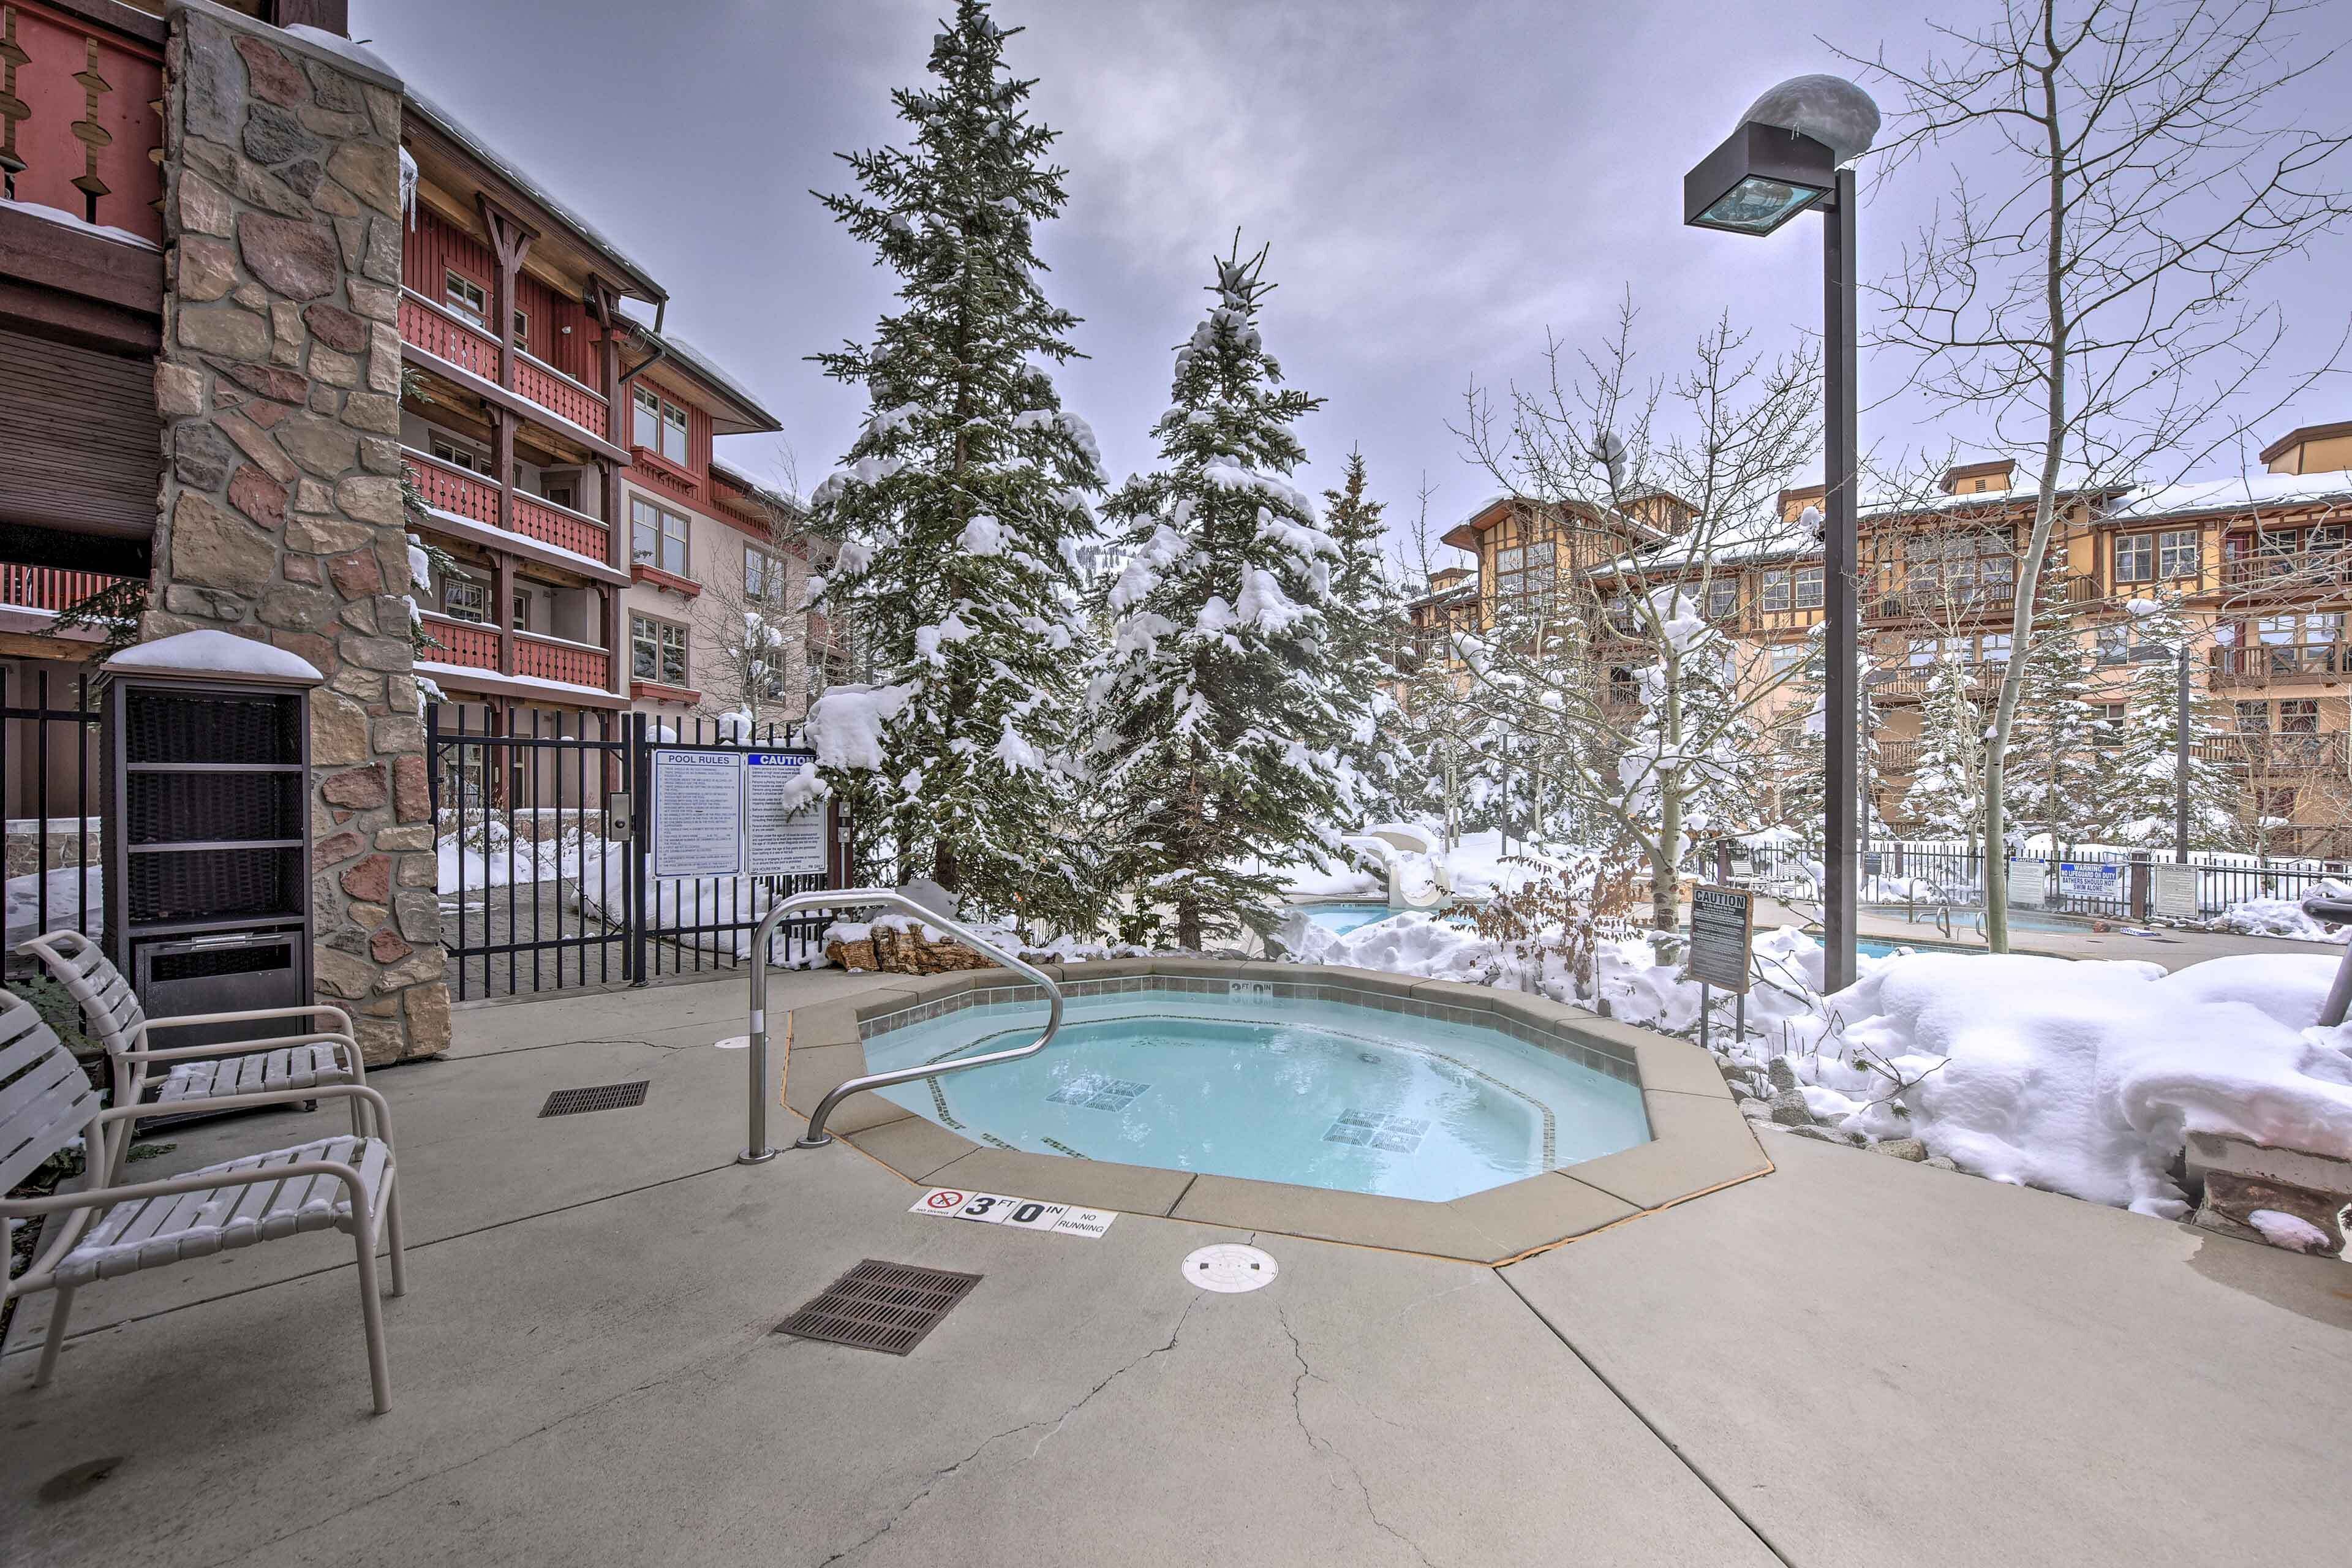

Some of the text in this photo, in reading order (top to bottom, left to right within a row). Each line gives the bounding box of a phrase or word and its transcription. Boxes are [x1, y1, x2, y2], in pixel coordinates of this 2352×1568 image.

[699, 756, 729, 764] RULES
[1696, 891, 1744, 907] CAUTION
[965, 1197, 1063, 1223] 3 FT 0 IN
[1058, 1220, 1104, 1232] RUNNING
